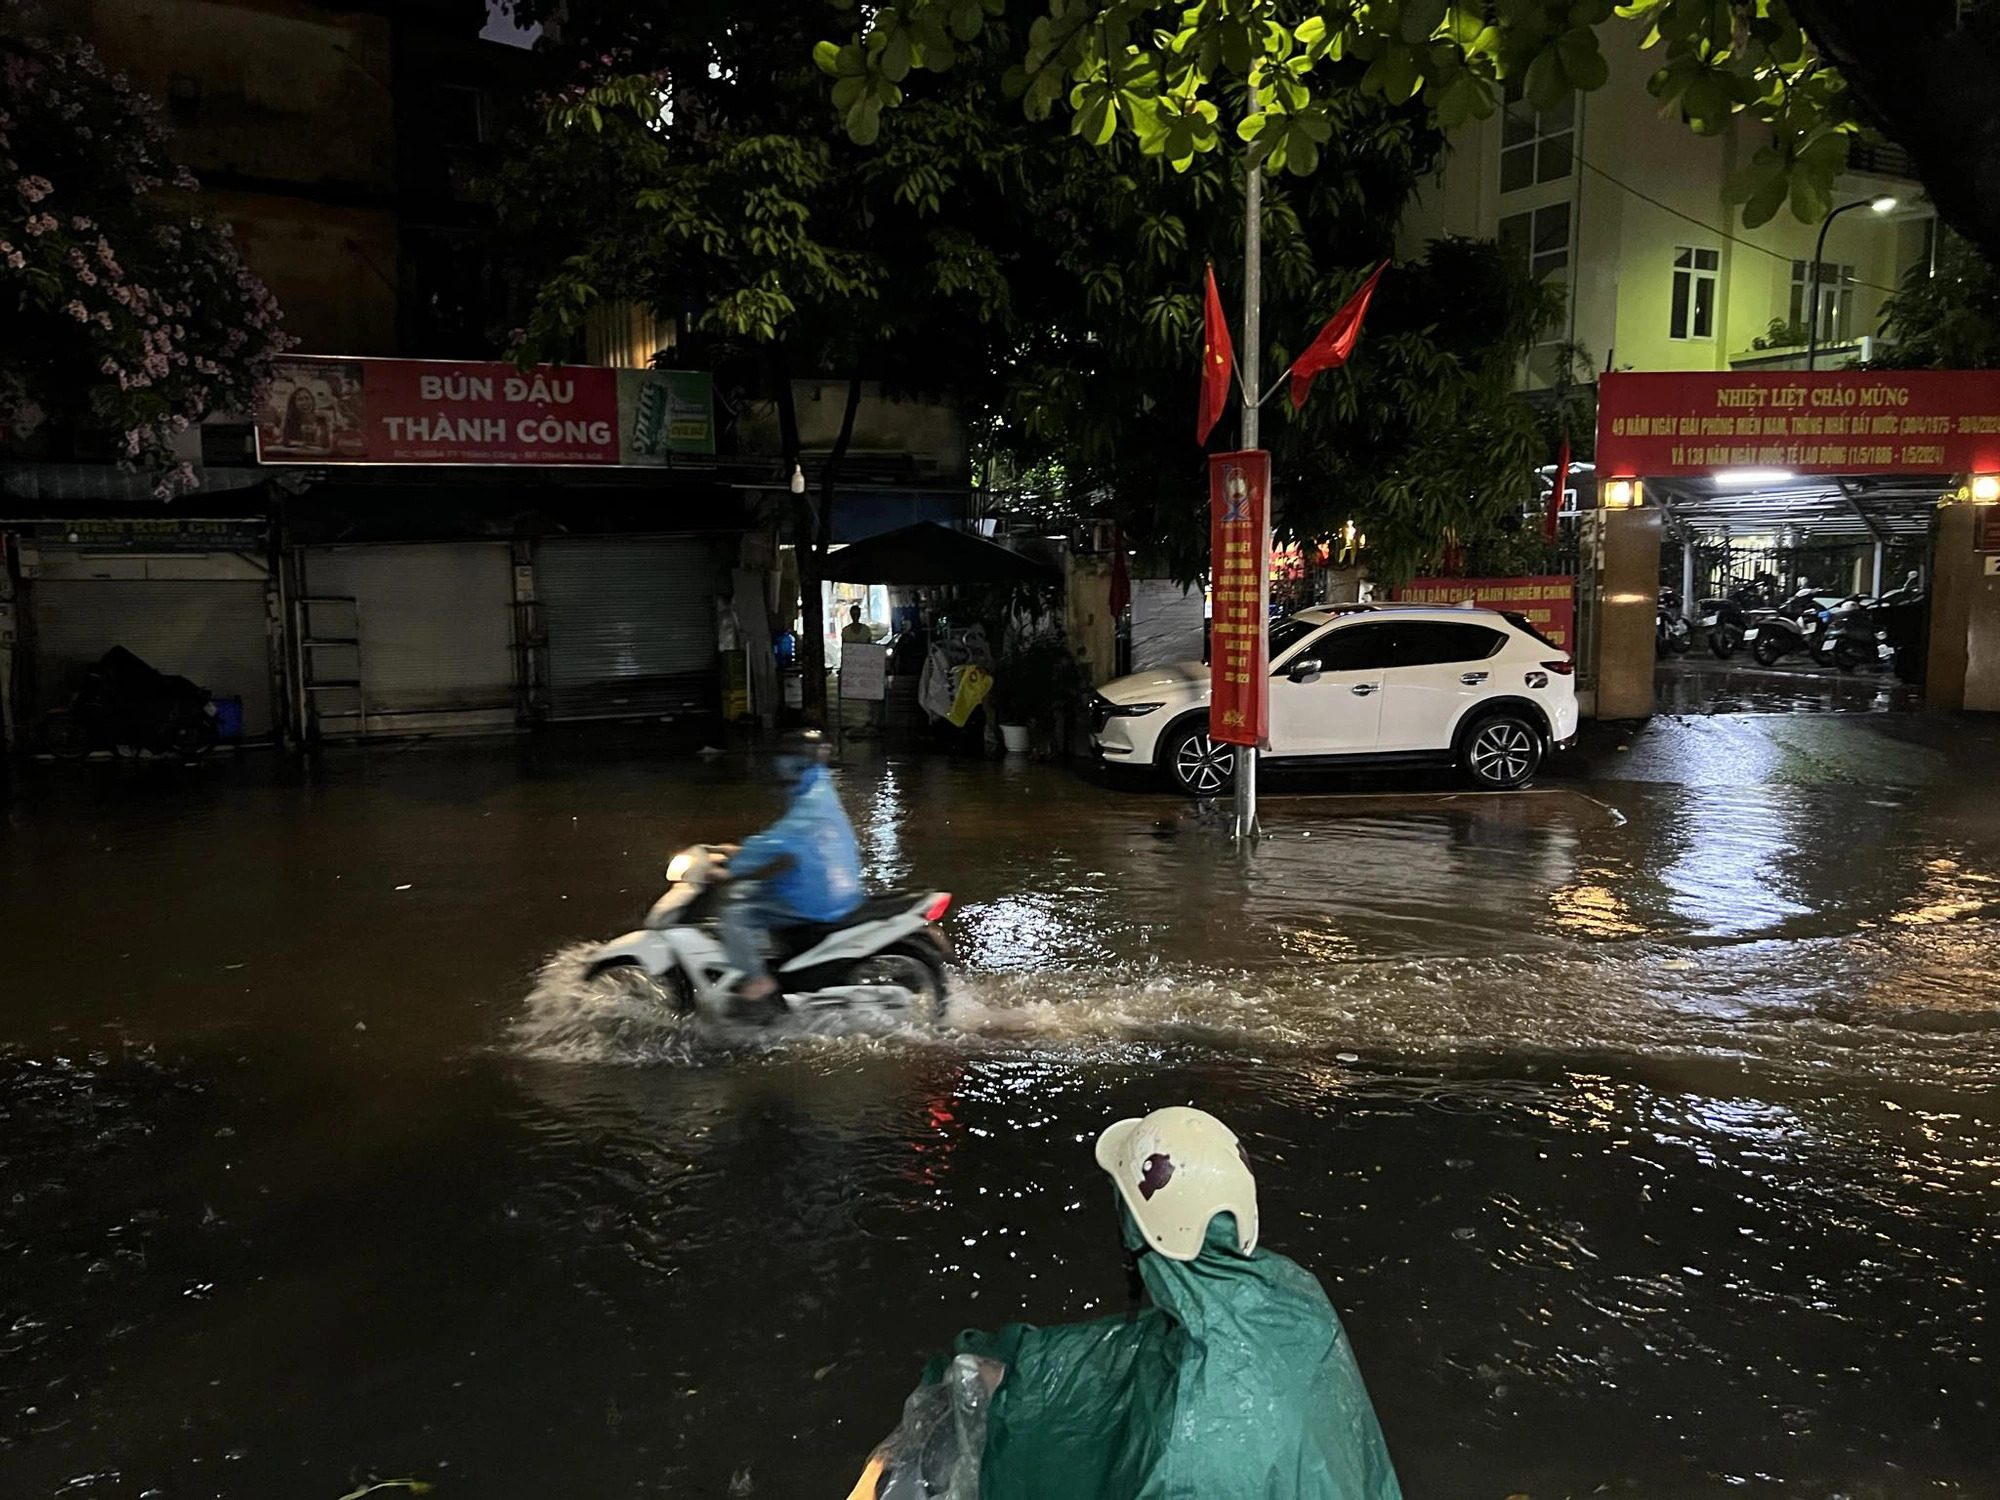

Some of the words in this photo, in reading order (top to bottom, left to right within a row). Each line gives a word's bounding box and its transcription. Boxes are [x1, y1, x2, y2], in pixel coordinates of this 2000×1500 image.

[420, 370, 494, 401] BÚN
[503, 373, 575, 409] ĐẬU
[1716, 382, 1768, 411] NHIỆT
[1771, 382, 1808, 411] LIỆT
[1811, 382, 1856, 406] CHÀO
[1859, 382, 1909, 406] MỪNG
[382, 412, 507, 442] THÀNH
[516, 414, 612, 445] CÔNG
[1651, 414, 1678, 436] NGÀY
[1672, 443, 1684, 465] VÀ
[1401, 586, 1426, 603] TOÀN
[1477, 585, 1503, 601] HÀNH
